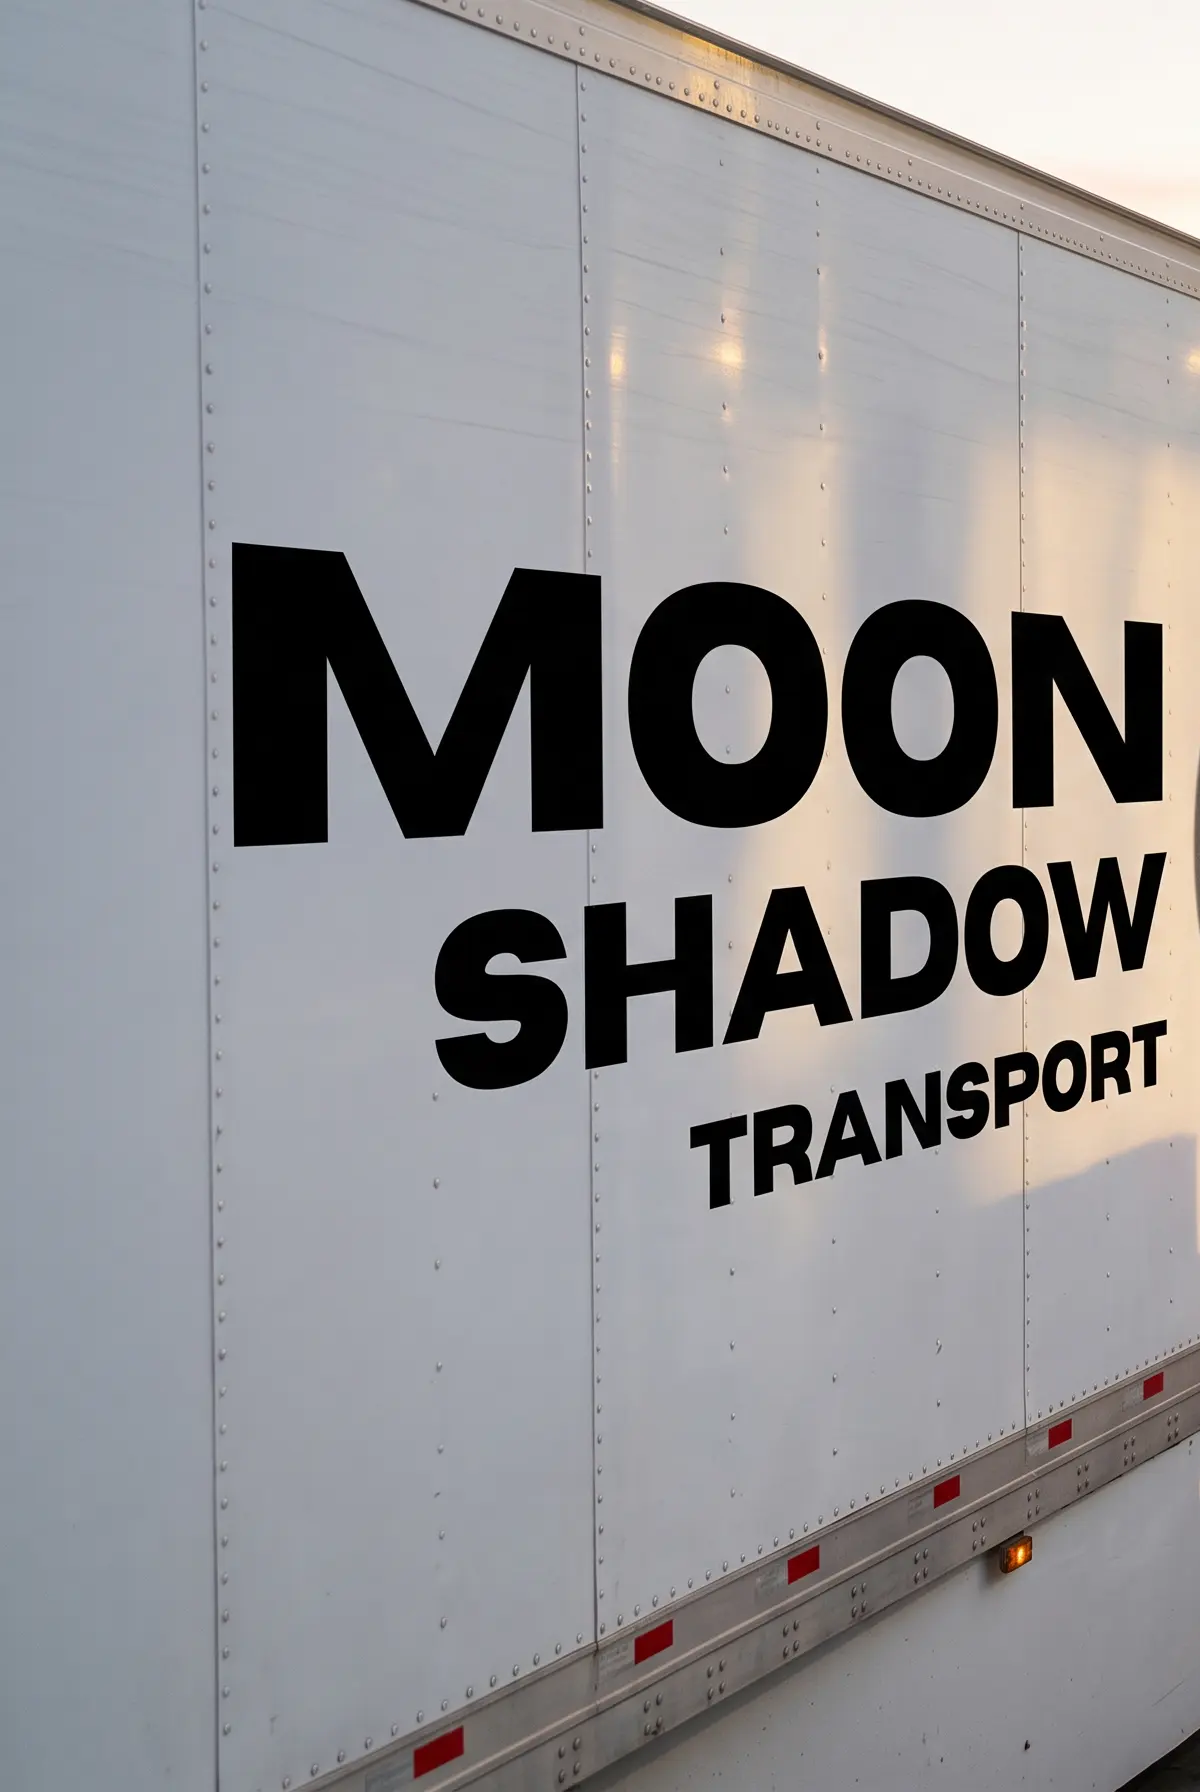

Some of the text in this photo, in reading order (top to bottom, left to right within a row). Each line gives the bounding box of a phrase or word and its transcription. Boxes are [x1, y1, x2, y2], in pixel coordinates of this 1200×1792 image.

[232, 542, 1163, 847] MOON
[434, 853, 1167, 1090] SHADOW
[690, 1020, 1167, 1210] TRANSPORT
